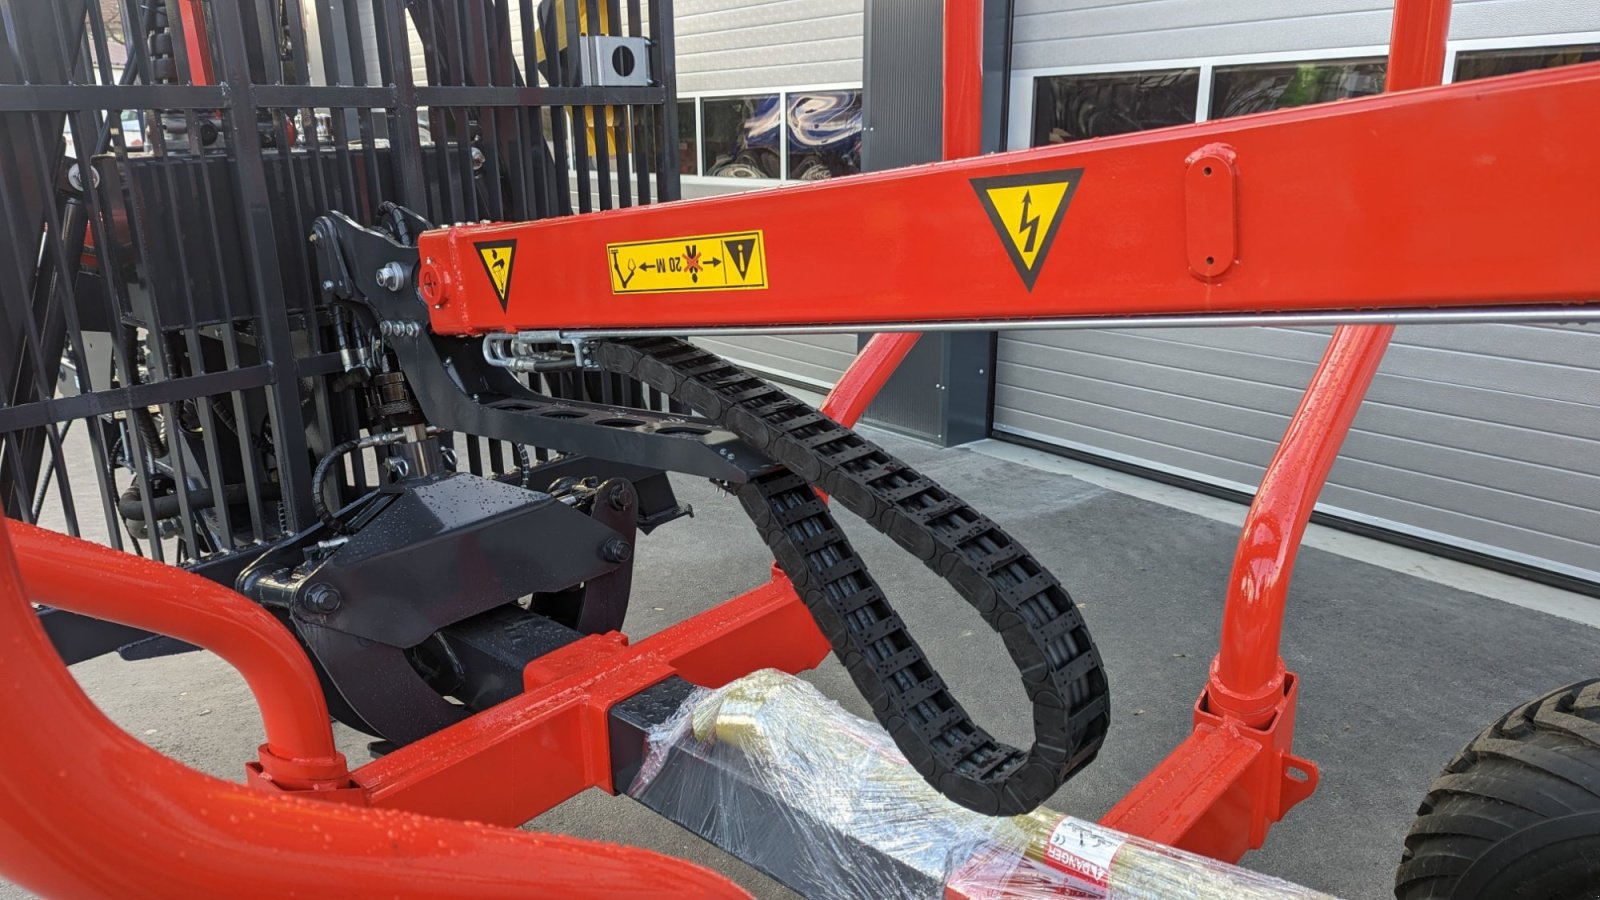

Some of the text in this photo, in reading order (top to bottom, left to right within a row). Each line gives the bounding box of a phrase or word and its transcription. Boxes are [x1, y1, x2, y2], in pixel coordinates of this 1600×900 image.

[656, 257, 682, 273] 20 M
[1054, 833, 1066, 845] CE
[1047, 846, 1091, 874] DANGER
